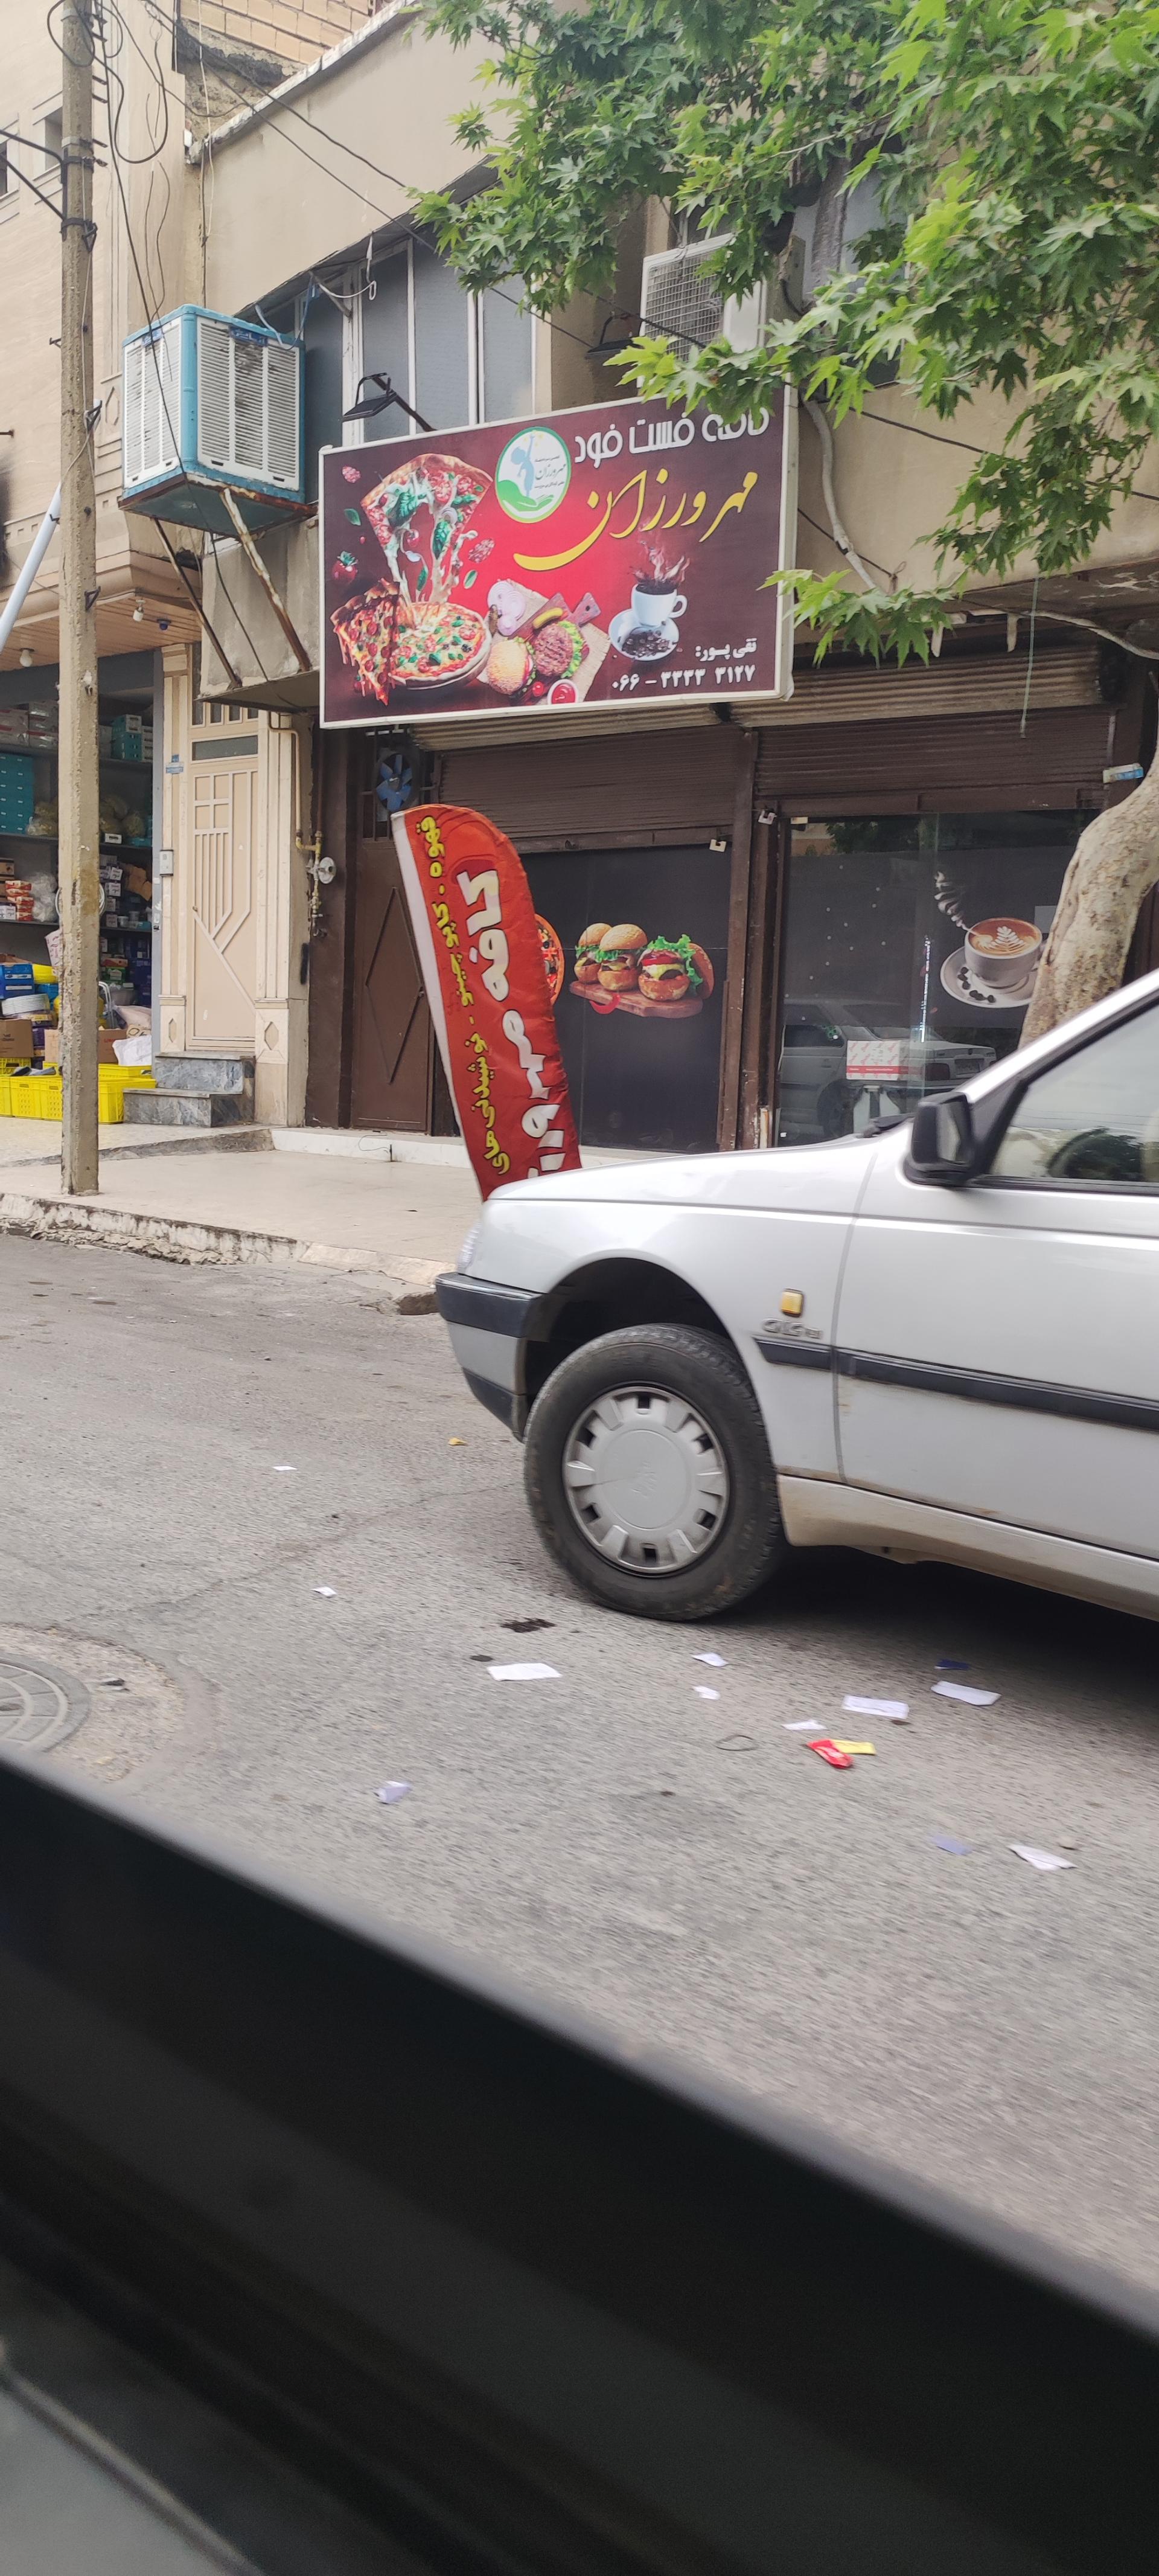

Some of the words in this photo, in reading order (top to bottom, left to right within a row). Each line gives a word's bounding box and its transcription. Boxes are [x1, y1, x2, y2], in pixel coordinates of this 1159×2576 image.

[575, 424, 624, 469] فود
[629, 412, 695, 454] فست
[457, 870, 509, 1001] کافه
